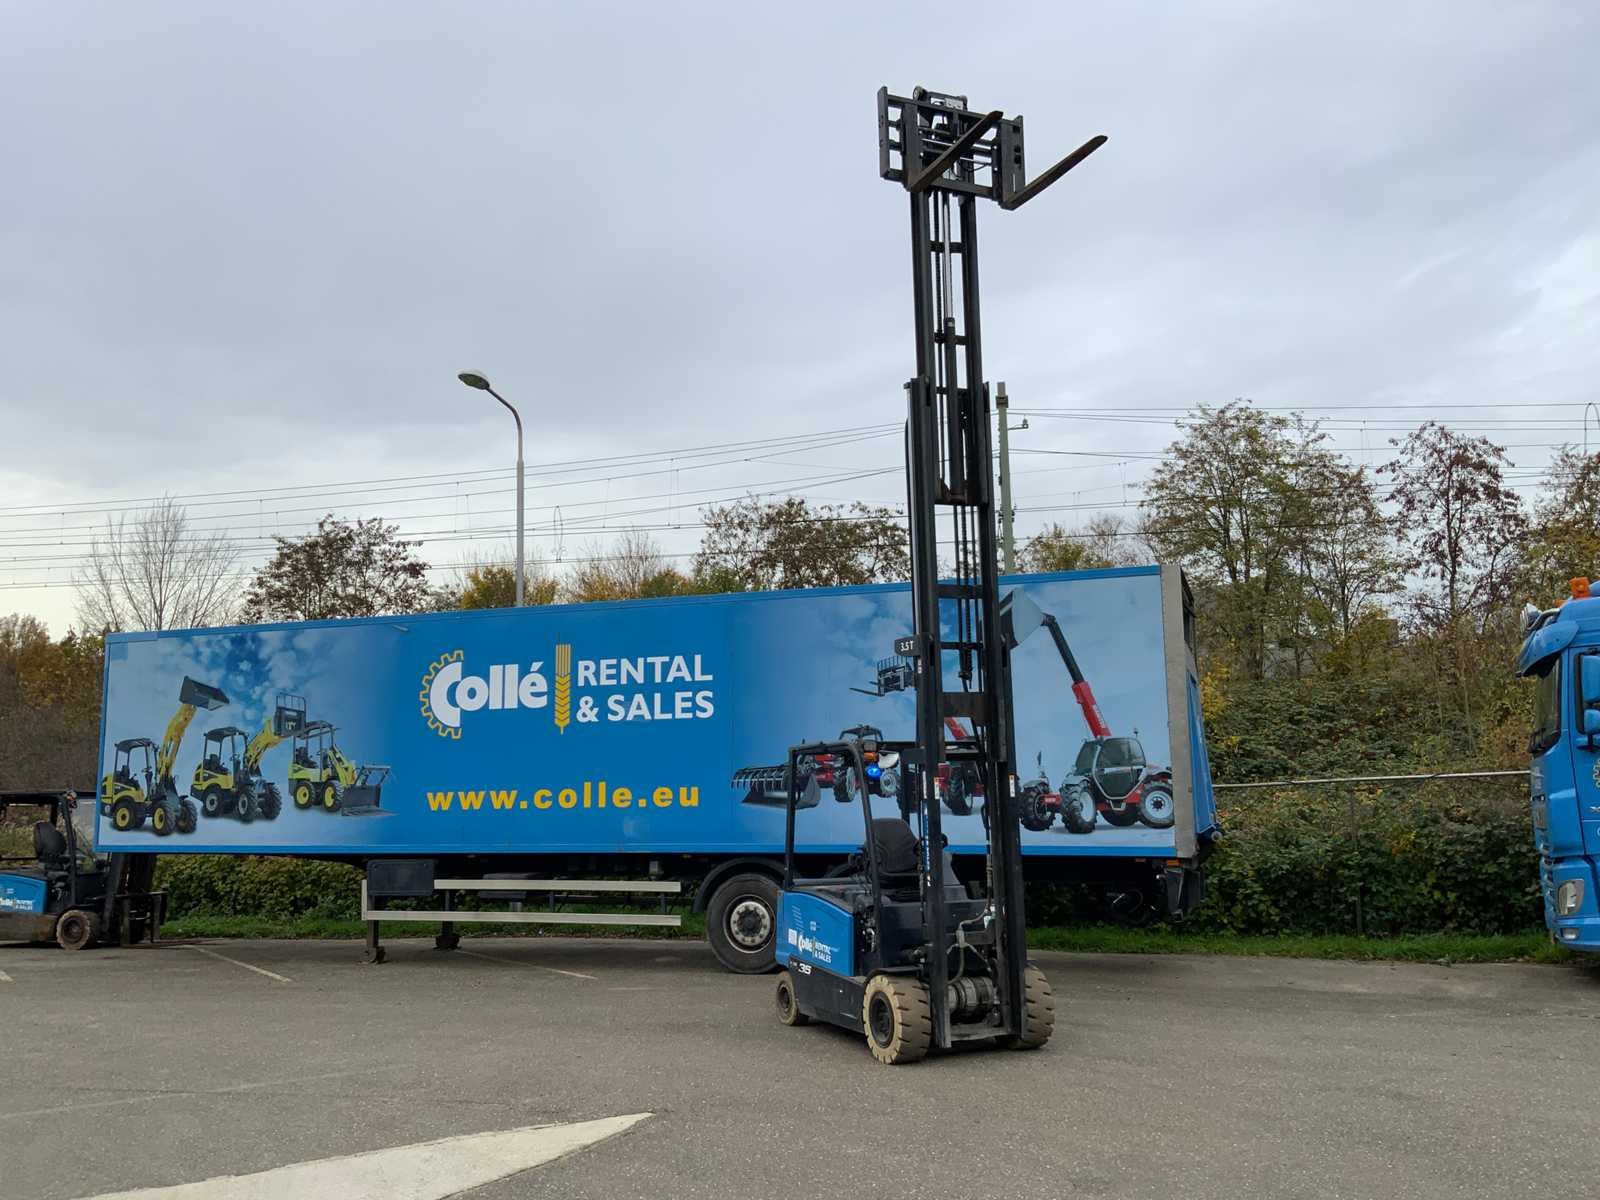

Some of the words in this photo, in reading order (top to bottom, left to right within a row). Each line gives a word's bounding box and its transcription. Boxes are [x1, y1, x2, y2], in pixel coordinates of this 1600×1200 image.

[577, 654, 713, 687] RENTAL
[429, 661, 548, 728] Collé
[576, 695, 599, 723] &
[607, 690, 714, 722] SALES
[426, 781, 699, 811] www.colle.eu
